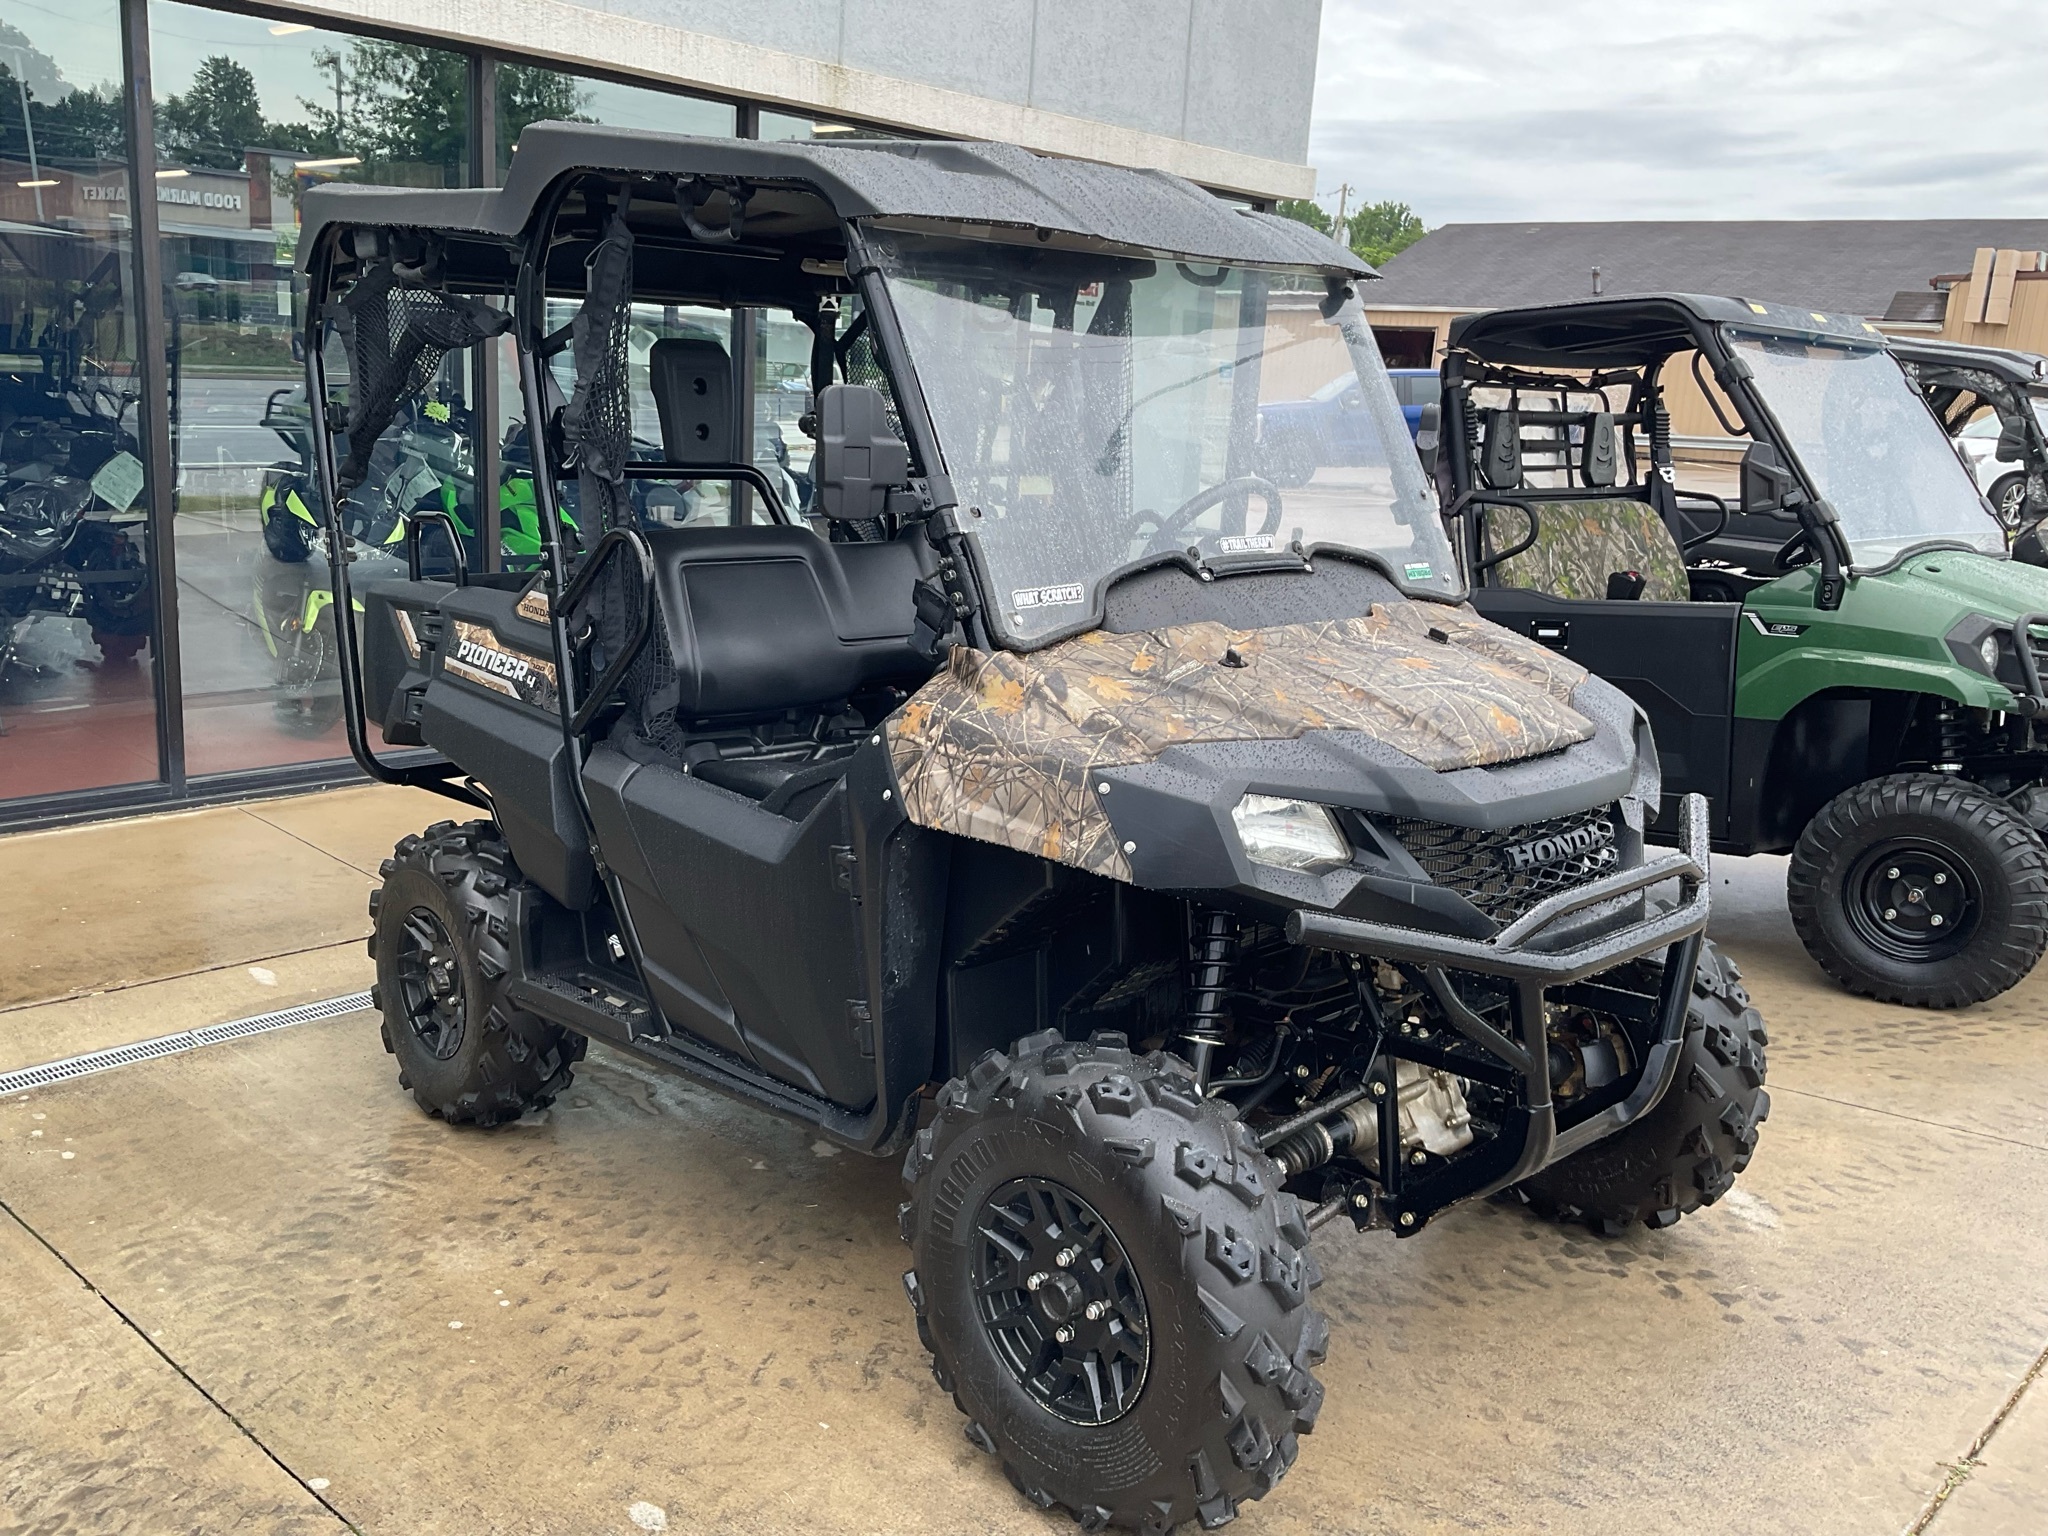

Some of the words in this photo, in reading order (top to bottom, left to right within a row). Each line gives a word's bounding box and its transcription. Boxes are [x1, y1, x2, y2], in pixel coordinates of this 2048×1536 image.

[1014, 591, 1039, 607] WHAT
[1040, 586, 1082, 603] SCRATCH?
[457, 639, 529, 682] PIONEER
[1504, 823, 1606, 873] HONDA
